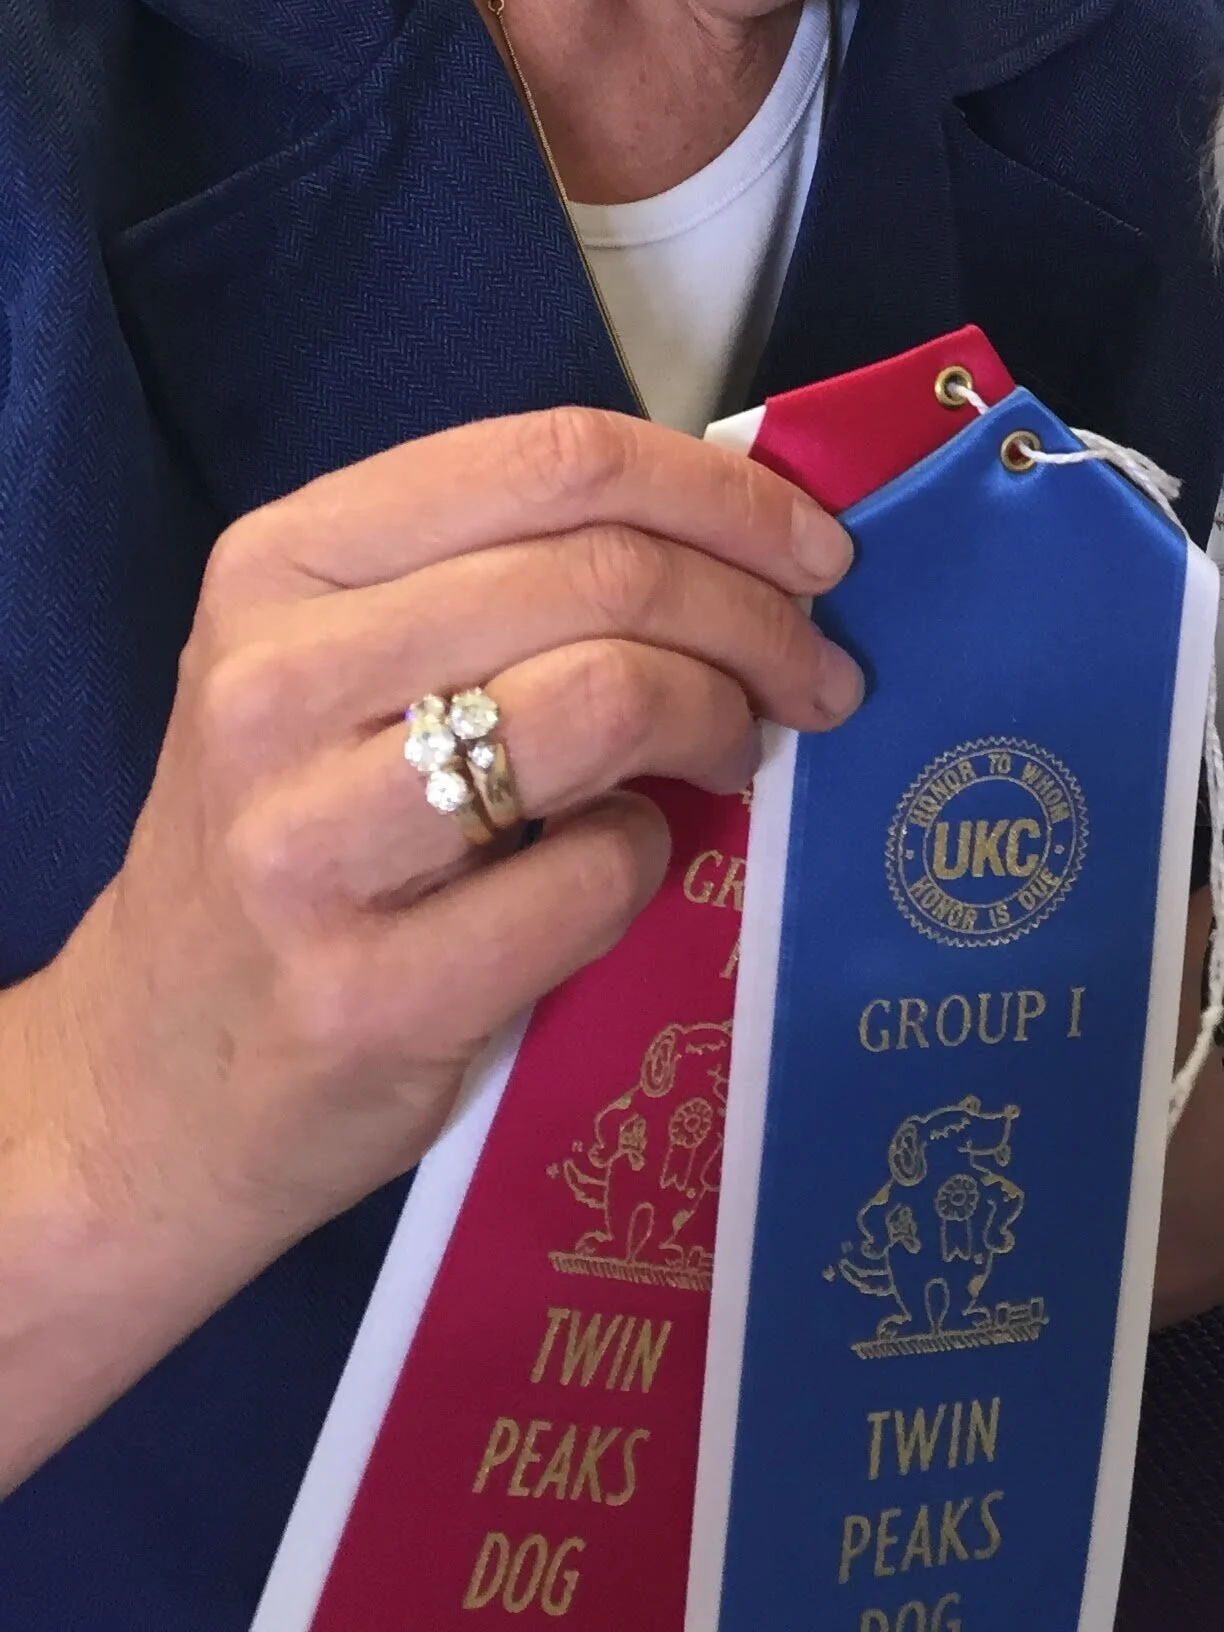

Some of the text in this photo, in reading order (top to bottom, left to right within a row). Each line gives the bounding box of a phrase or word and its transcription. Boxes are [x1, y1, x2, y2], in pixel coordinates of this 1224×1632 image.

[908, 752, 1071, 828] HONOR TO WHOM
[932, 818, 1041, 880] UKC
[908, 875, 978, 930] HONOR
[989, 903, 1011, 928] IS
[858, 992, 1046, 1053] GROUP
[530, 1307, 672, 1392] TWIN
[471, 1416, 650, 1506] PEAKS
[867, 1396, 1000, 1480] TWIN
[462, 1532, 586, 1616] DOG
[838, 1490, 1004, 1585] PEAKS
